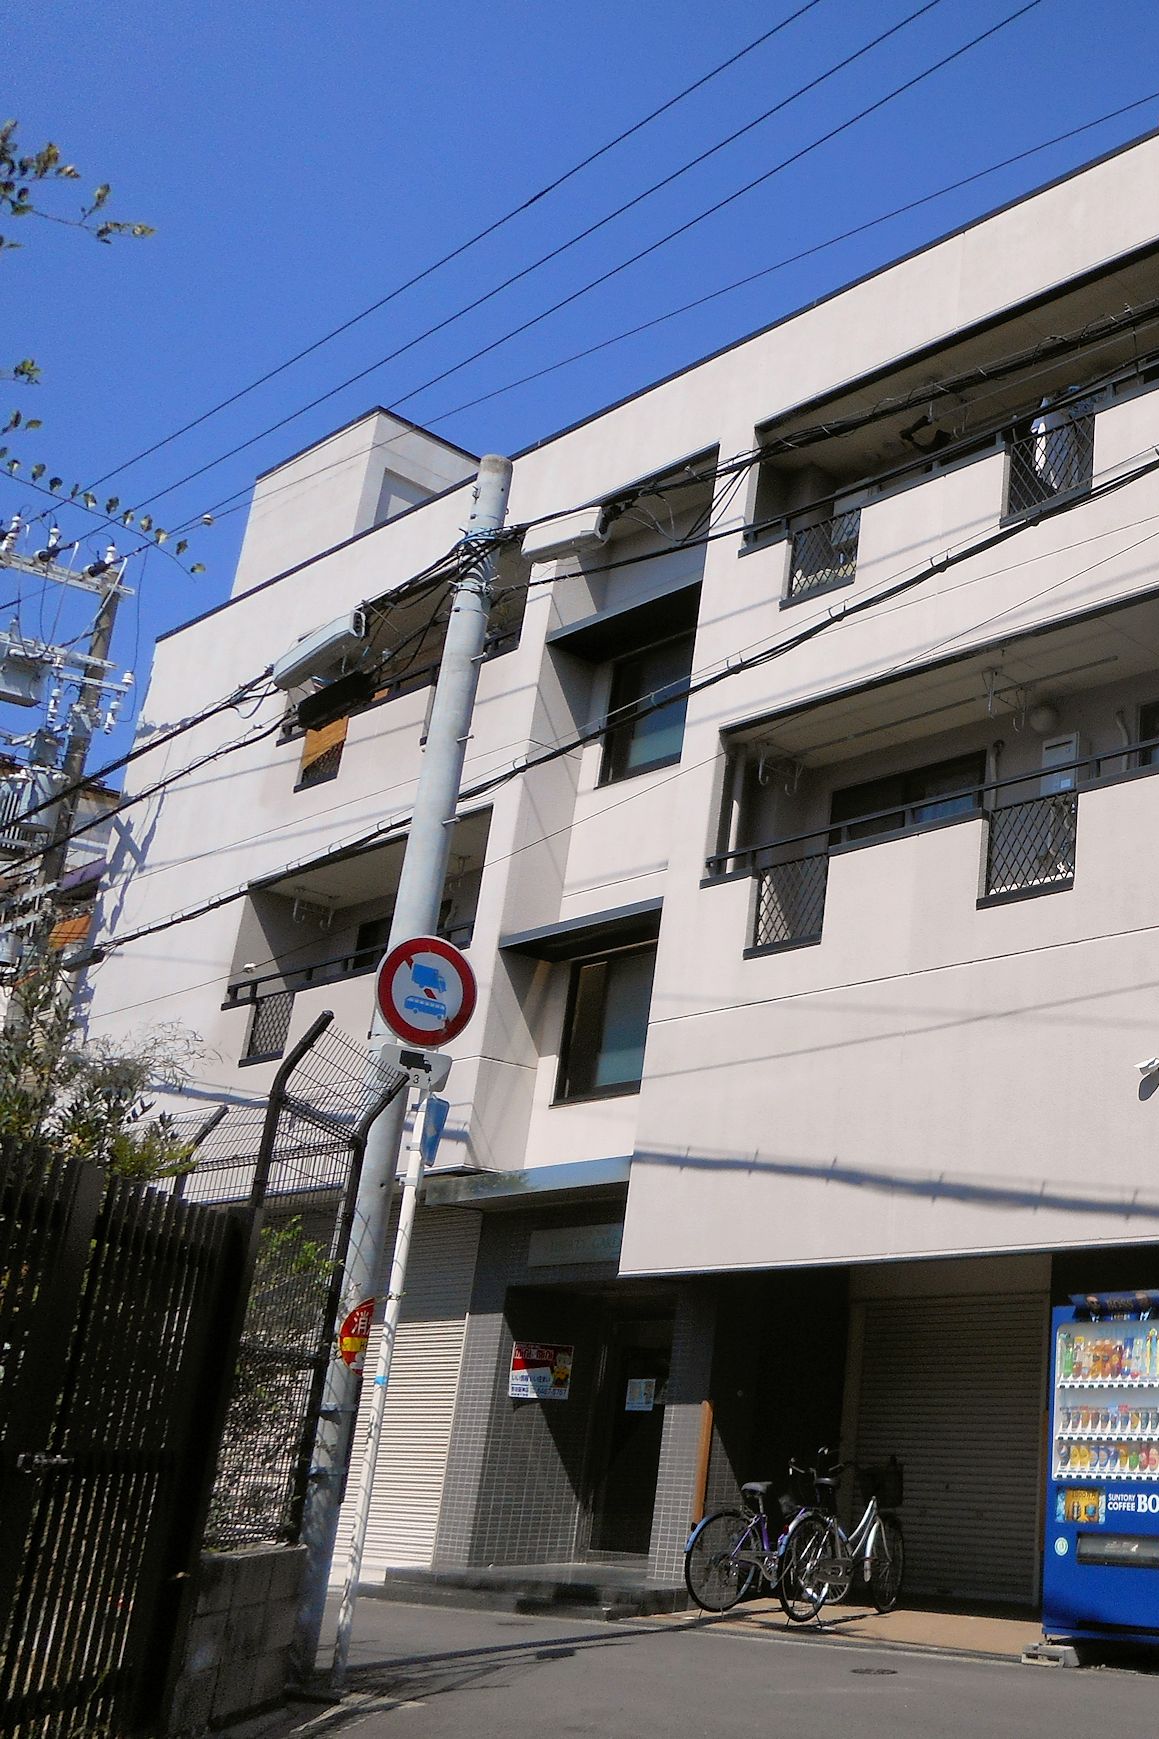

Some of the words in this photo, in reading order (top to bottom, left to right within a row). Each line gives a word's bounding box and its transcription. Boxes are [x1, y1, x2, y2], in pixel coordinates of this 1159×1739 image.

[413, 1074, 420, 1084] 3
[1108, 1493, 1136, 1502] SUNTORY
[1107, 1502, 1136, 1511] COFFEE
